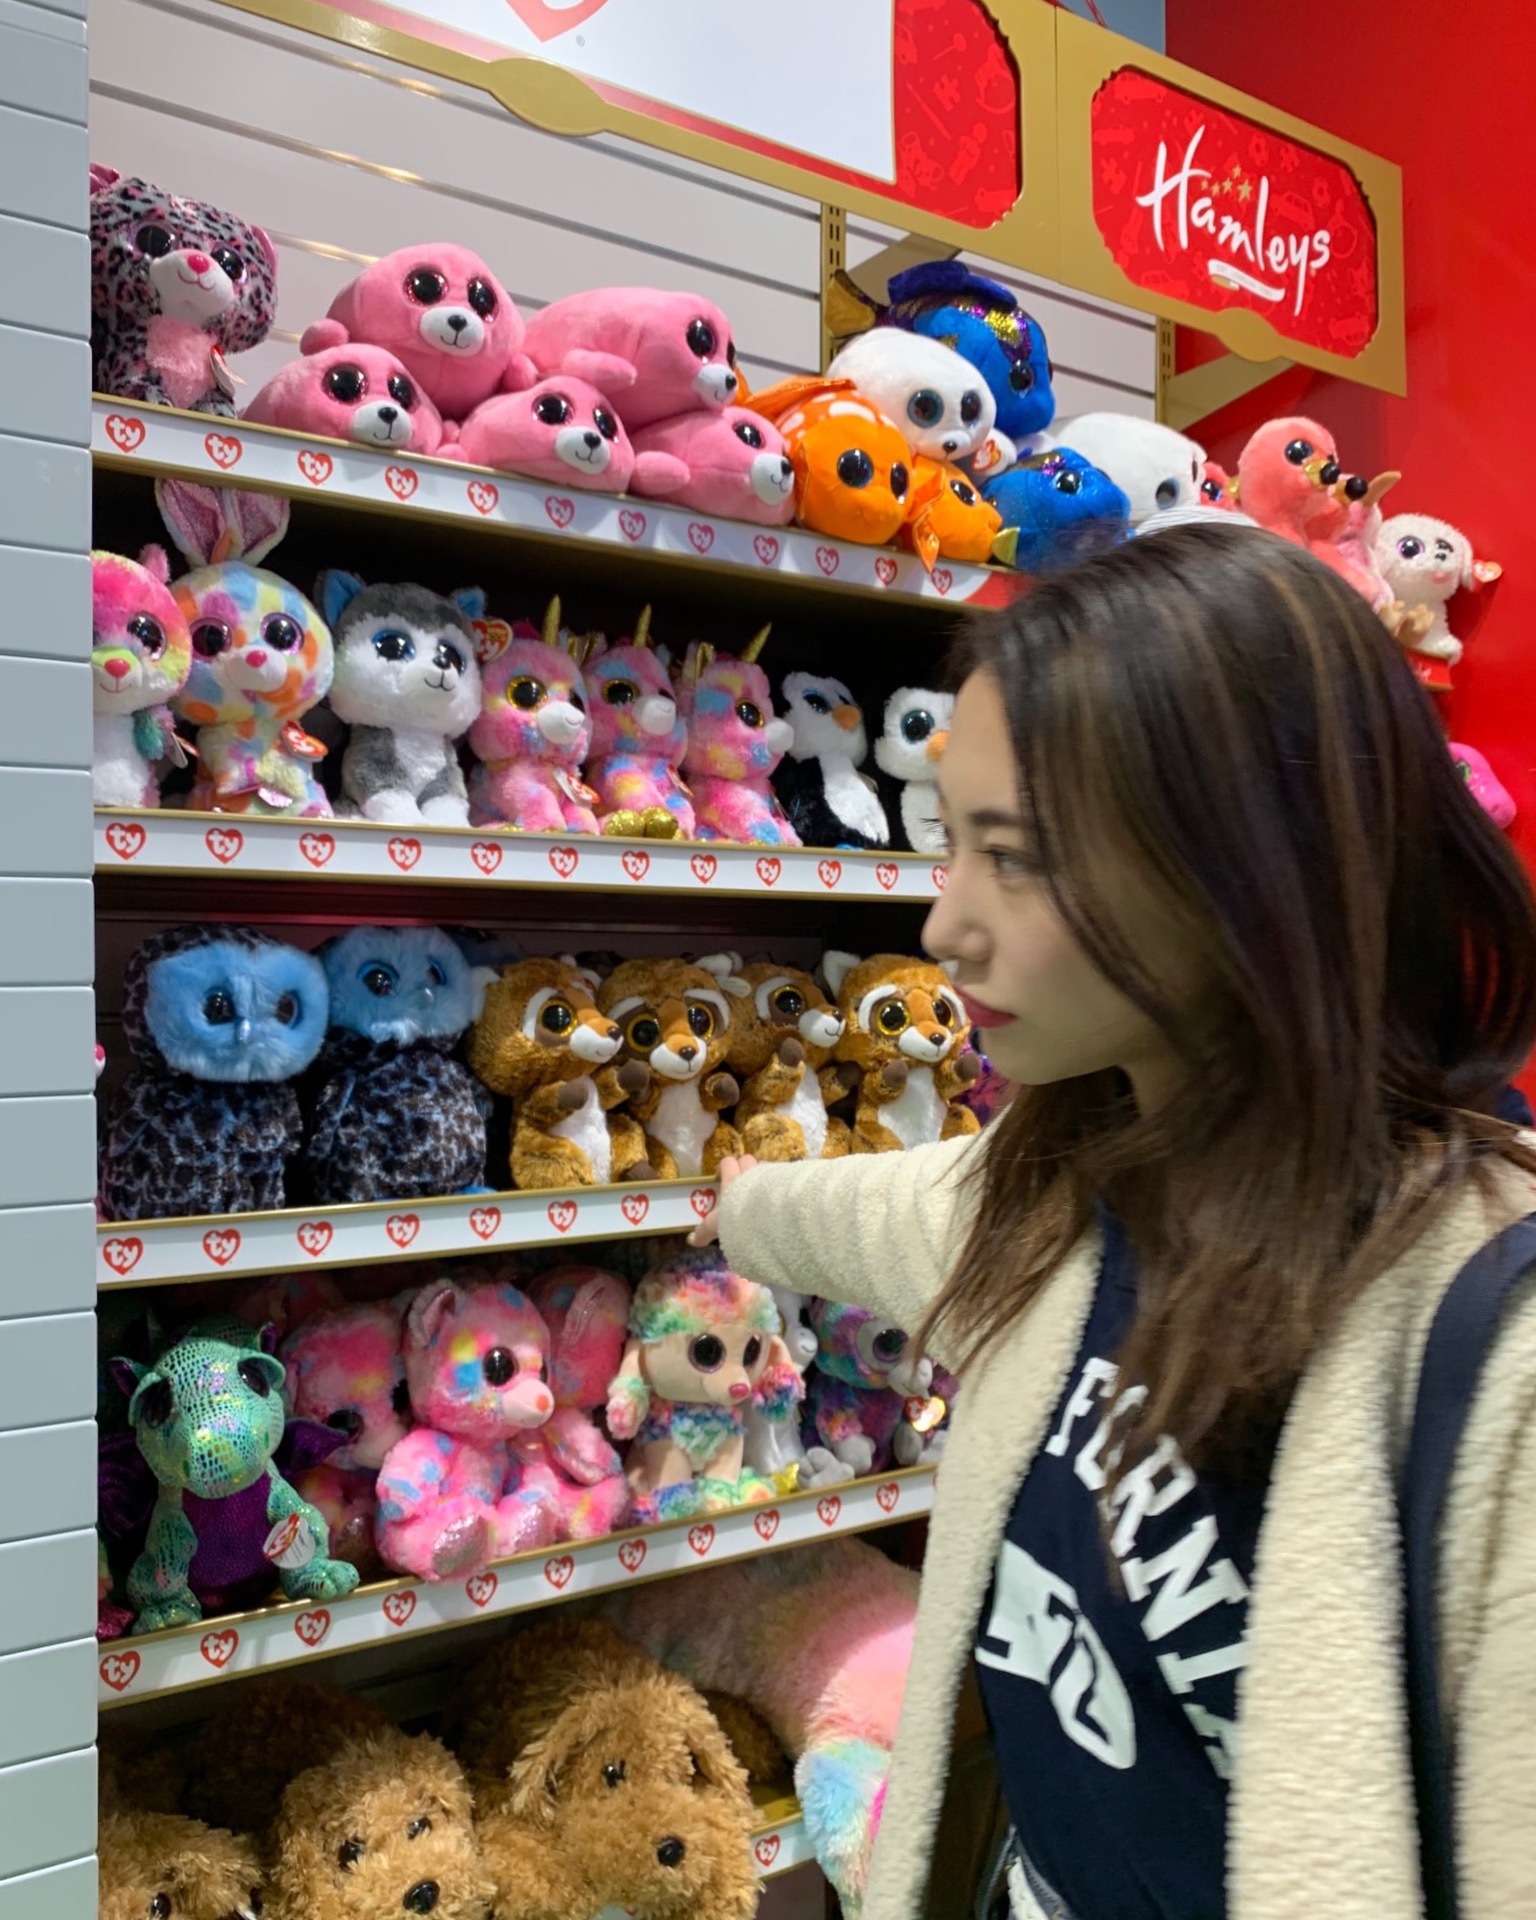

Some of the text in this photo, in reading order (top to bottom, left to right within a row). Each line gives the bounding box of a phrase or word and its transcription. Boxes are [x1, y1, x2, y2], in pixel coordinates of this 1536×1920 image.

[1134, 124, 1332, 317] Hamleys
[108, 416, 141, 447] ty
[207, 435, 239, 465] ty
[300, 453, 329, 481] ty
[387, 468, 415, 496] ty
[469, 483, 496, 510] ty
[547, 497, 572, 524] ty
[620, 512, 644, 536] ty
[689, 525, 712, 549] ty
[754, 536, 776, 559] ty
[108, 825, 142, 853] ty
[207, 830, 239, 857] ty
[300, 835, 332, 861] ty
[389, 839, 417, 865] ty
[472, 844, 499, 869] ty
[550, 849, 575, 873] ty
[623, 852, 648, 875] ty
[692, 855, 715, 879] ty
[757, 860, 779, 882] ty
[818, 861, 840, 884] ty
[877, 864, 897, 886] ty
[106, 1191, 716, 1269] ty ty ty ty ty ty ty ty
[103, 1656, 138, 1683] ty
[202, 1634, 236, 1661] ty
[296, 1613, 327, 1639] ty
[384, 1594, 413, 1620] ty
[468, 1577, 495, 1601] ty
[546, 1559, 572, 1582] ty
